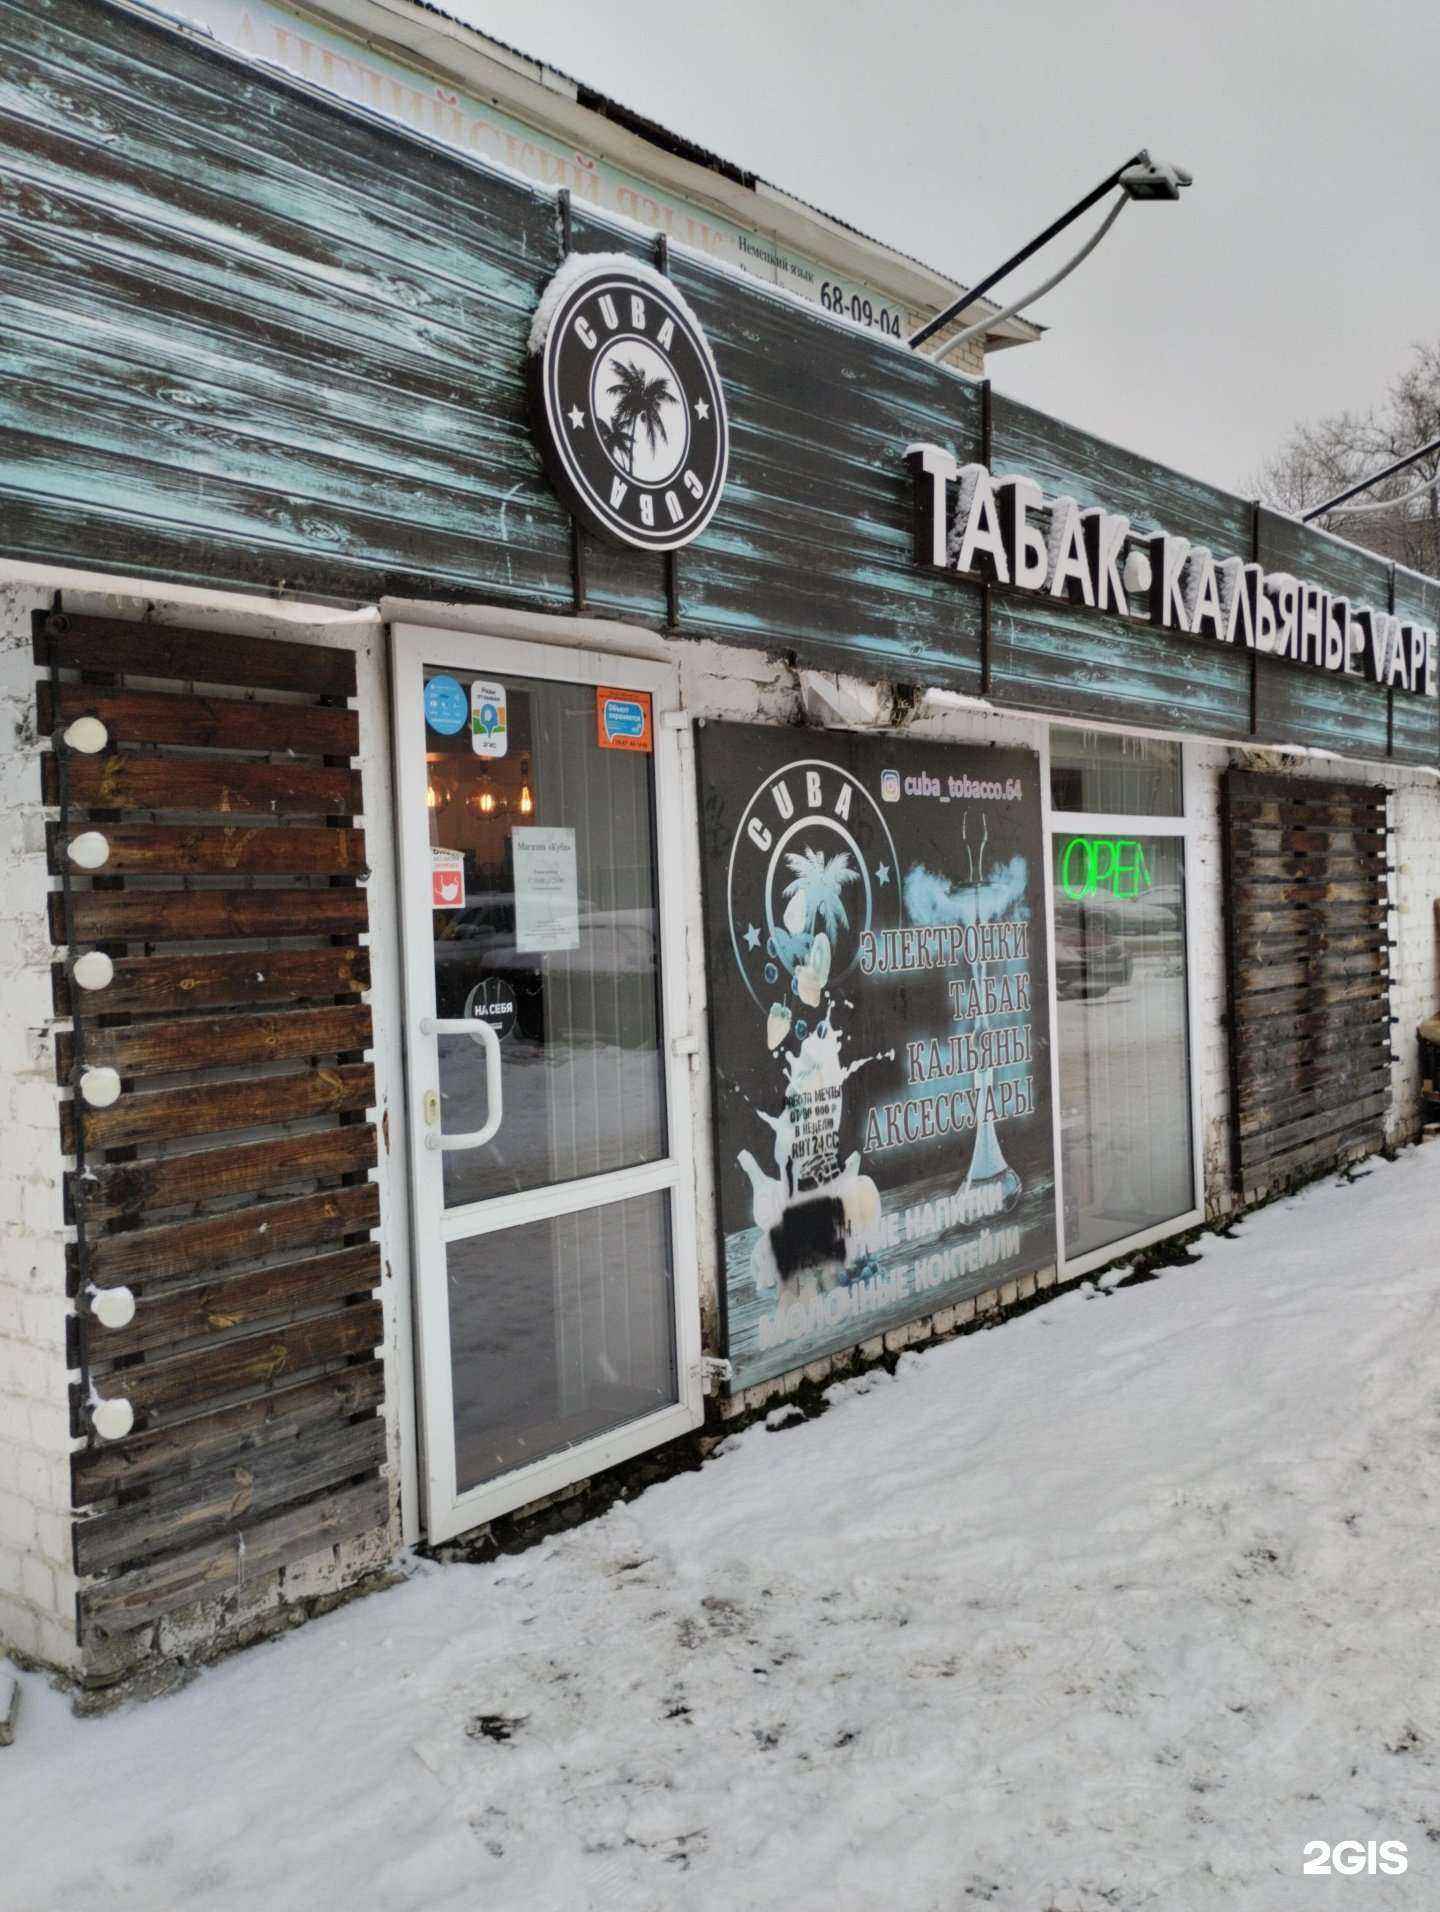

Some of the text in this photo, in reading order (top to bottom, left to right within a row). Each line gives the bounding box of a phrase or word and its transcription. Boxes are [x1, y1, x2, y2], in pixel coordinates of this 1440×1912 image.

[573, 294, 675, 351] CUBA
[820, 281, 901, 340] 68-09-04
[609, 469, 705, 528] CUBA
[918, 446, 1438, 698] ТАБАК КАЛЬЯНЫ VAPE
[747, 770, 853, 852] CUBA
[904, 771, 1022, 803] cuba_tobacco.64
[859, 921, 1030, 975] ЭЛЕКТРОНКИ
[948, 972, 1031, 1021] ТАБАК
[906, 1023, 1033, 1084] КАЛЬЯНЫ
[863, 1075, 1035, 1153] АКСЕССУАРЫ
